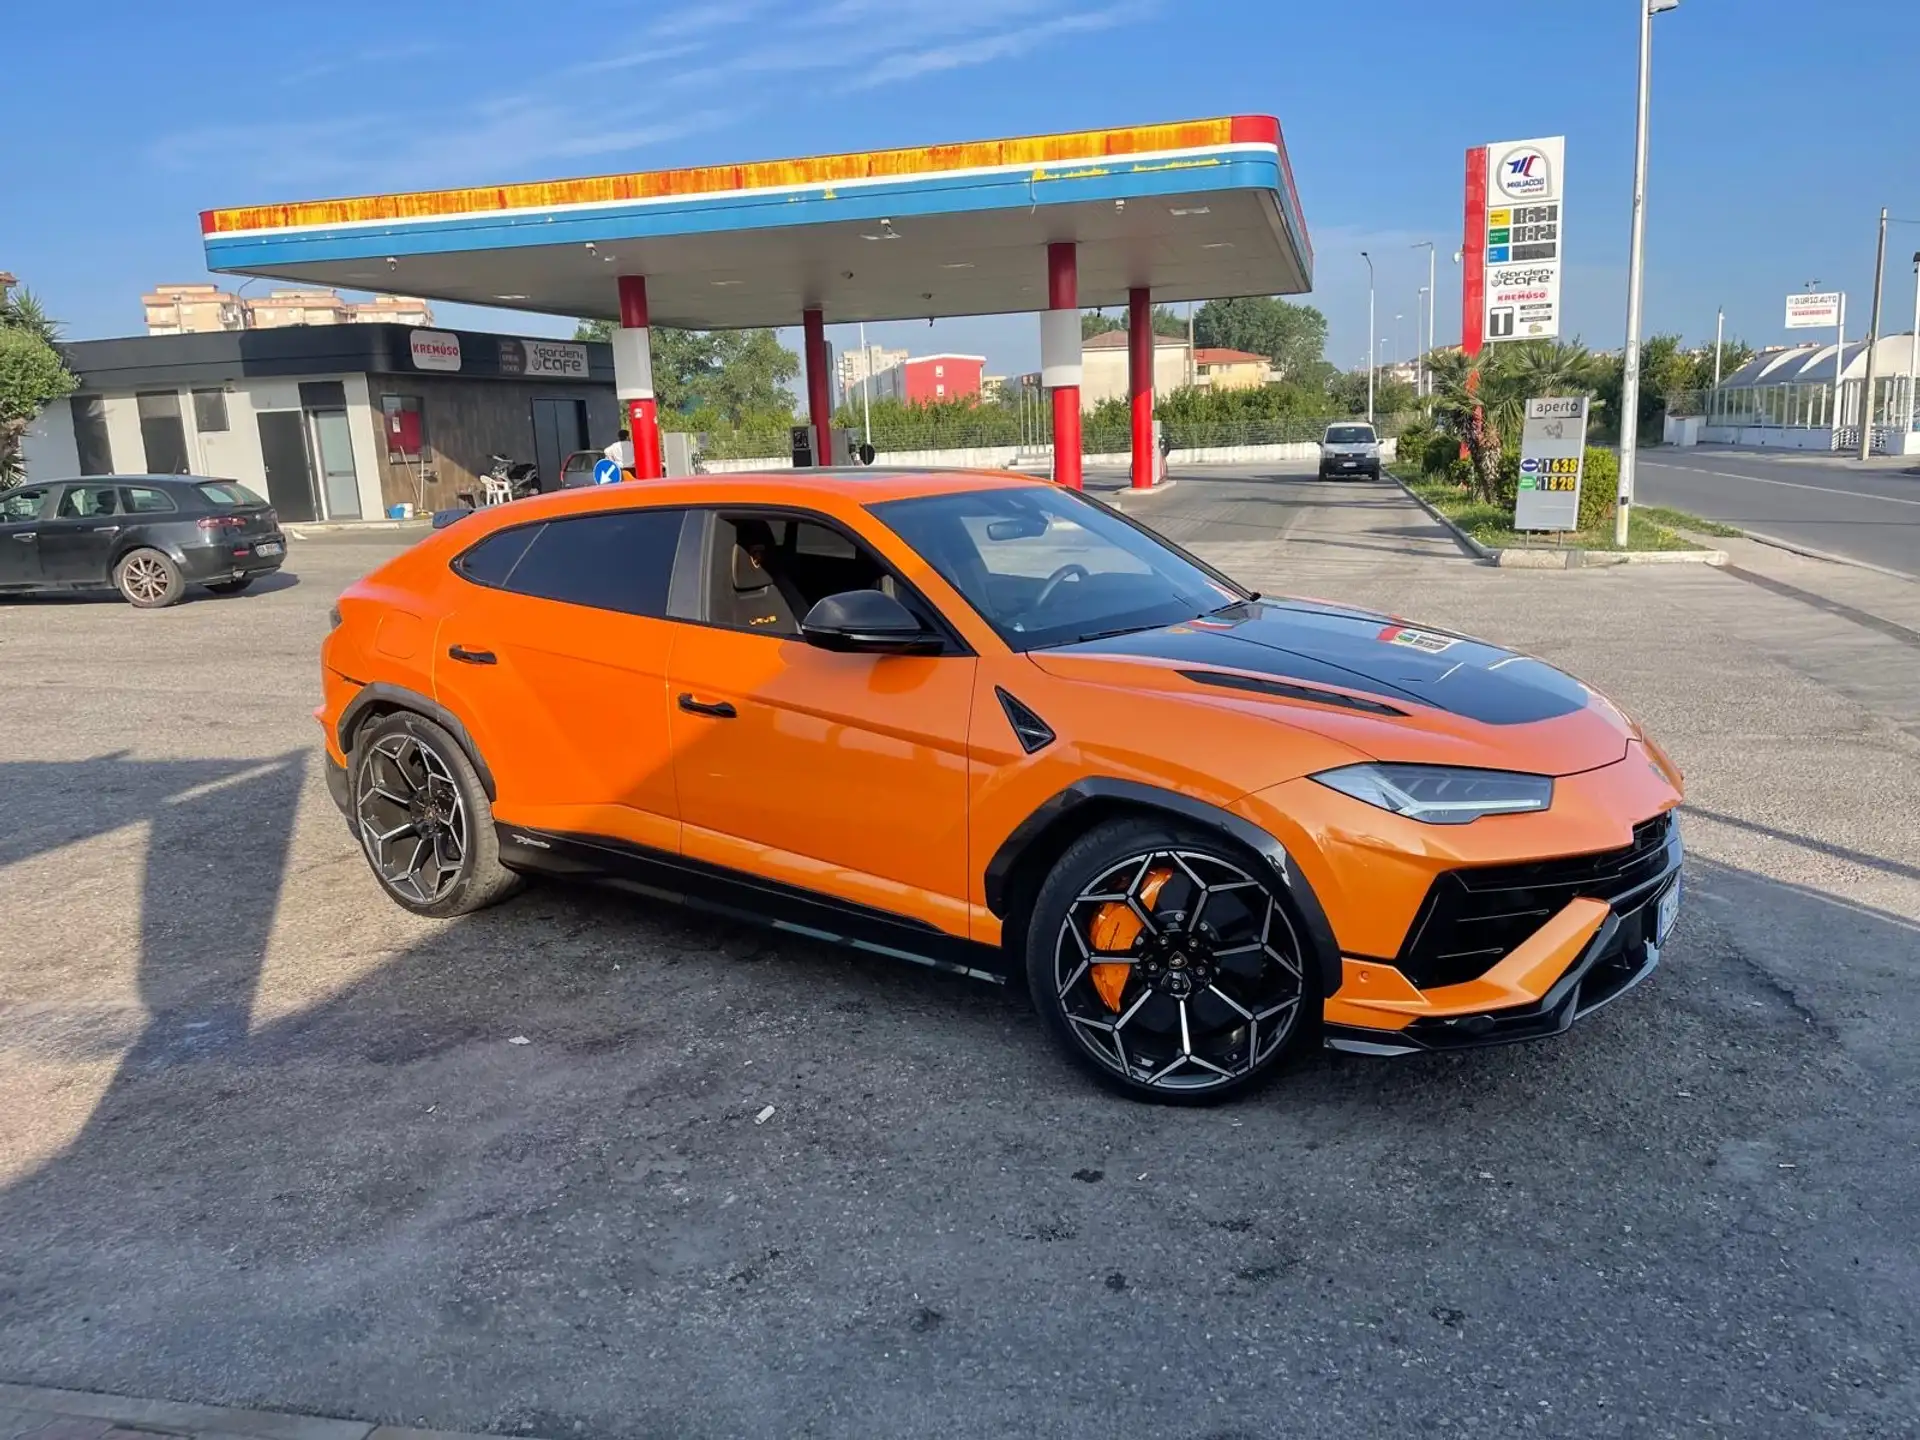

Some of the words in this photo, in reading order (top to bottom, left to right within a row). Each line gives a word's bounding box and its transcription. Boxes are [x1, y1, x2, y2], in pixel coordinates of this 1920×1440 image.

[1536, 401, 1578, 414] aperto
[1545, 459, 1577, 473] 1638
[1543, 477, 1575, 490] 1828
